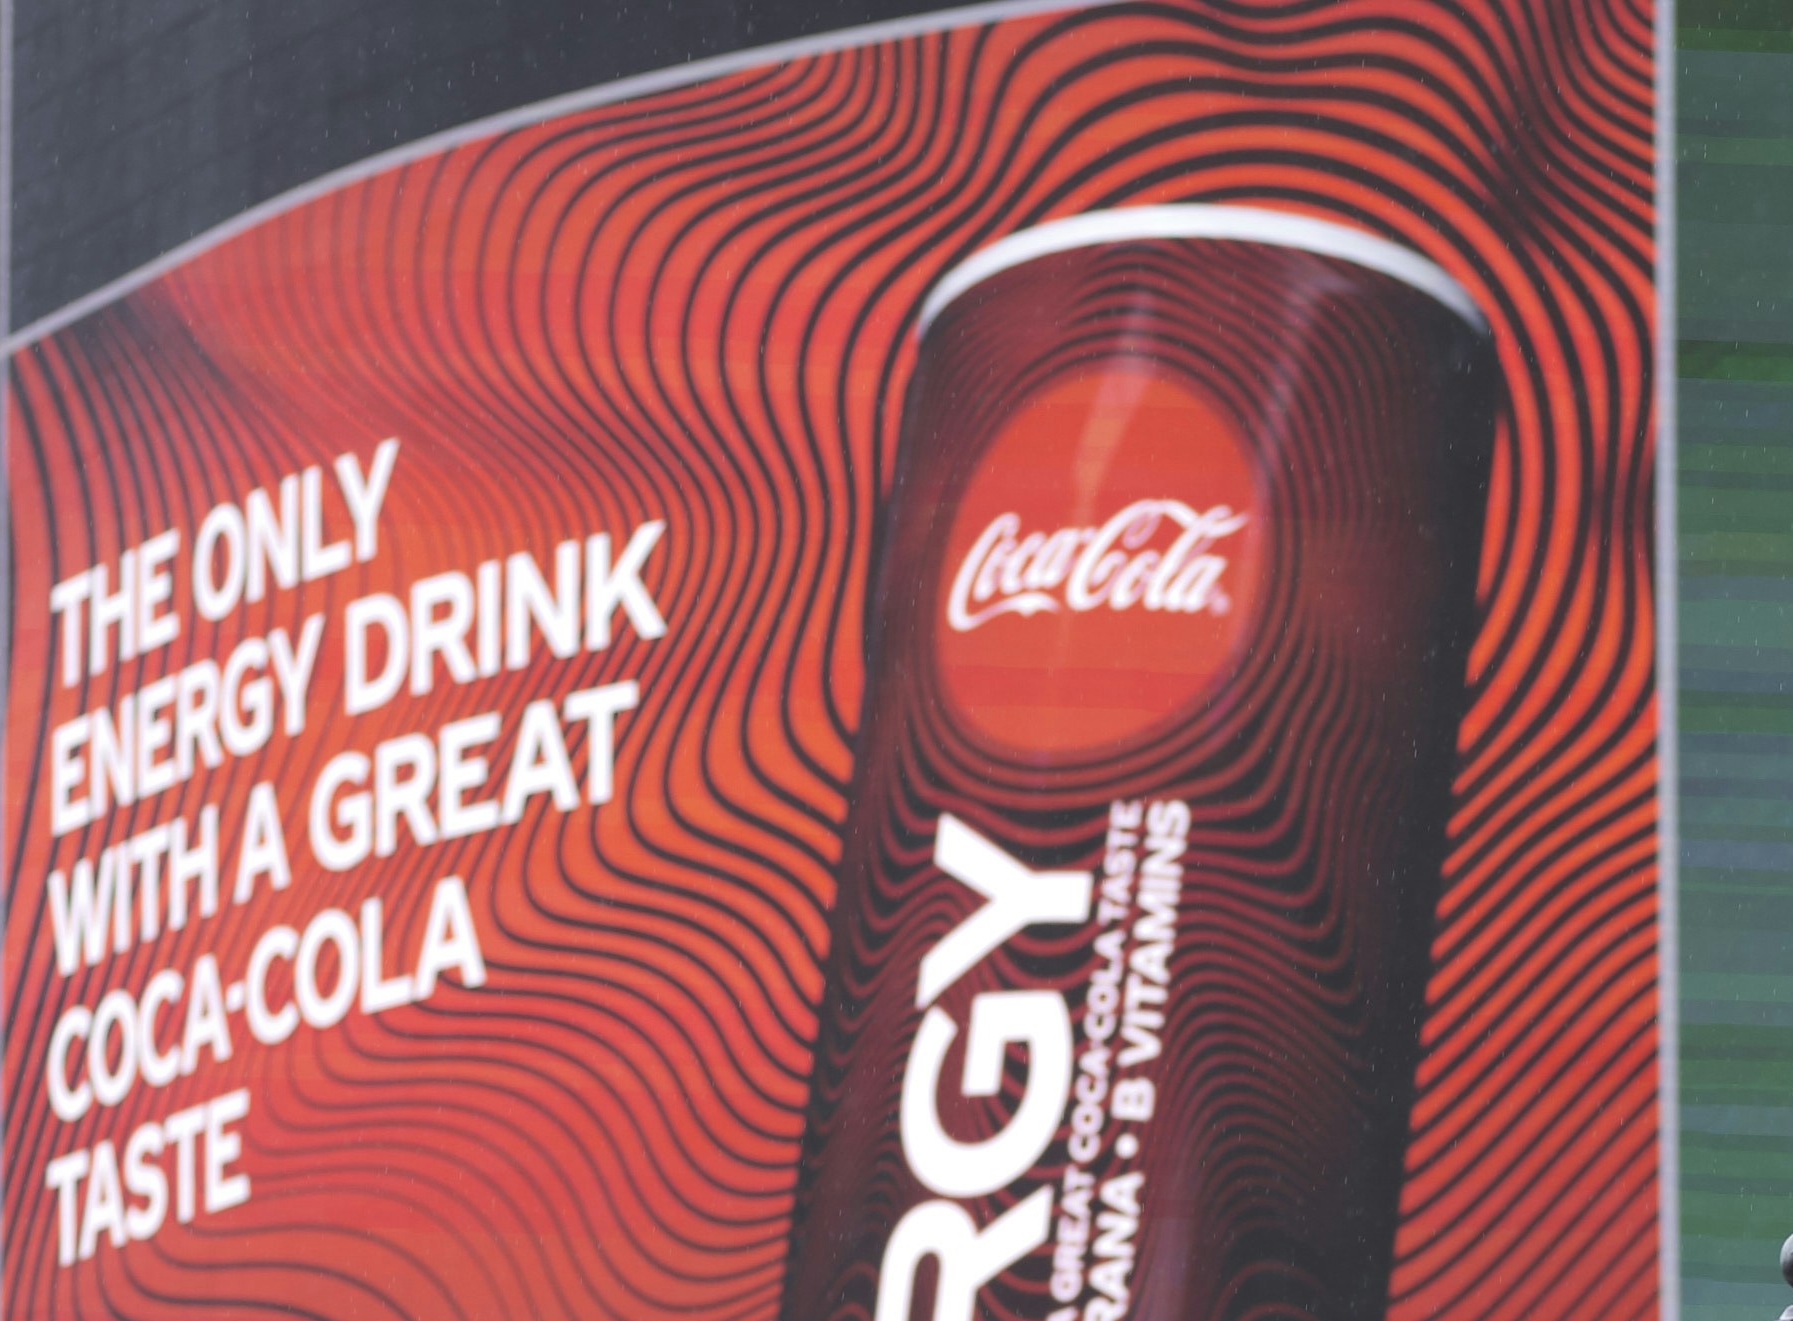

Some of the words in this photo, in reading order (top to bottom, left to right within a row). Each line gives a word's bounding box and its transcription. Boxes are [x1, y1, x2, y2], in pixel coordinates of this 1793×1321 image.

[50, 528, 180, 689] THE
[192, 437, 400, 622] ONLY
[50, 612, 325, 838] ENERGY
[343, 519, 669, 716] DRINK
[47, 804, 219, 977] WITH
[233, 781, 292, 904] A
[309, 680, 640, 872] GREAT
[1118, 799, 1191, 1068] VITAMINS
[47, 875, 487, 1122] COCA-COLA
[1050, 1165, 1096, 1303] GREAT
[1098, 799, 1143, 927] TASTE
[46, 1087, 251, 1267] TASTE
